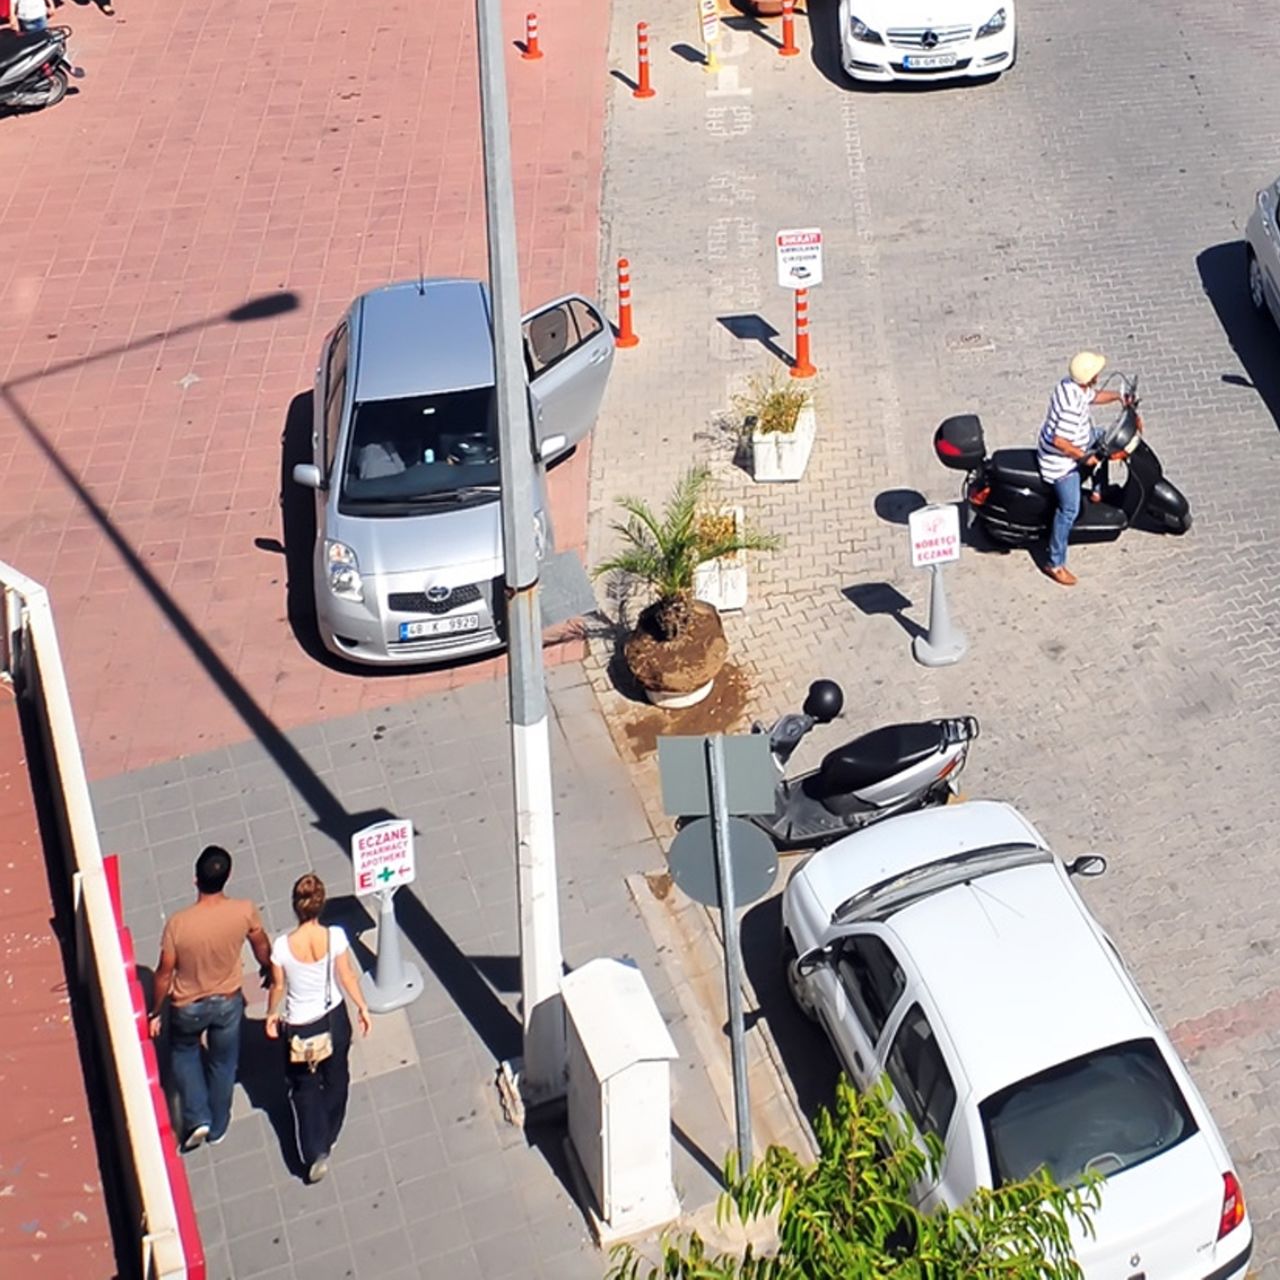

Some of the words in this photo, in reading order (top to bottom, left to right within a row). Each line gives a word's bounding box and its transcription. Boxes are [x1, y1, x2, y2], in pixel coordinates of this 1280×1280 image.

[917, 547, 954, 562] ECZANE
[409, 624, 423, 636] 48
[432, 622, 440, 633] K
[448, 616, 478, 632] 9929
[358, 826, 409, 851] ECZANE
[360, 840, 409, 860] PHARMACY
[361, 850, 407, 870] APOTHEKE
[359, 871, 374, 890] E
